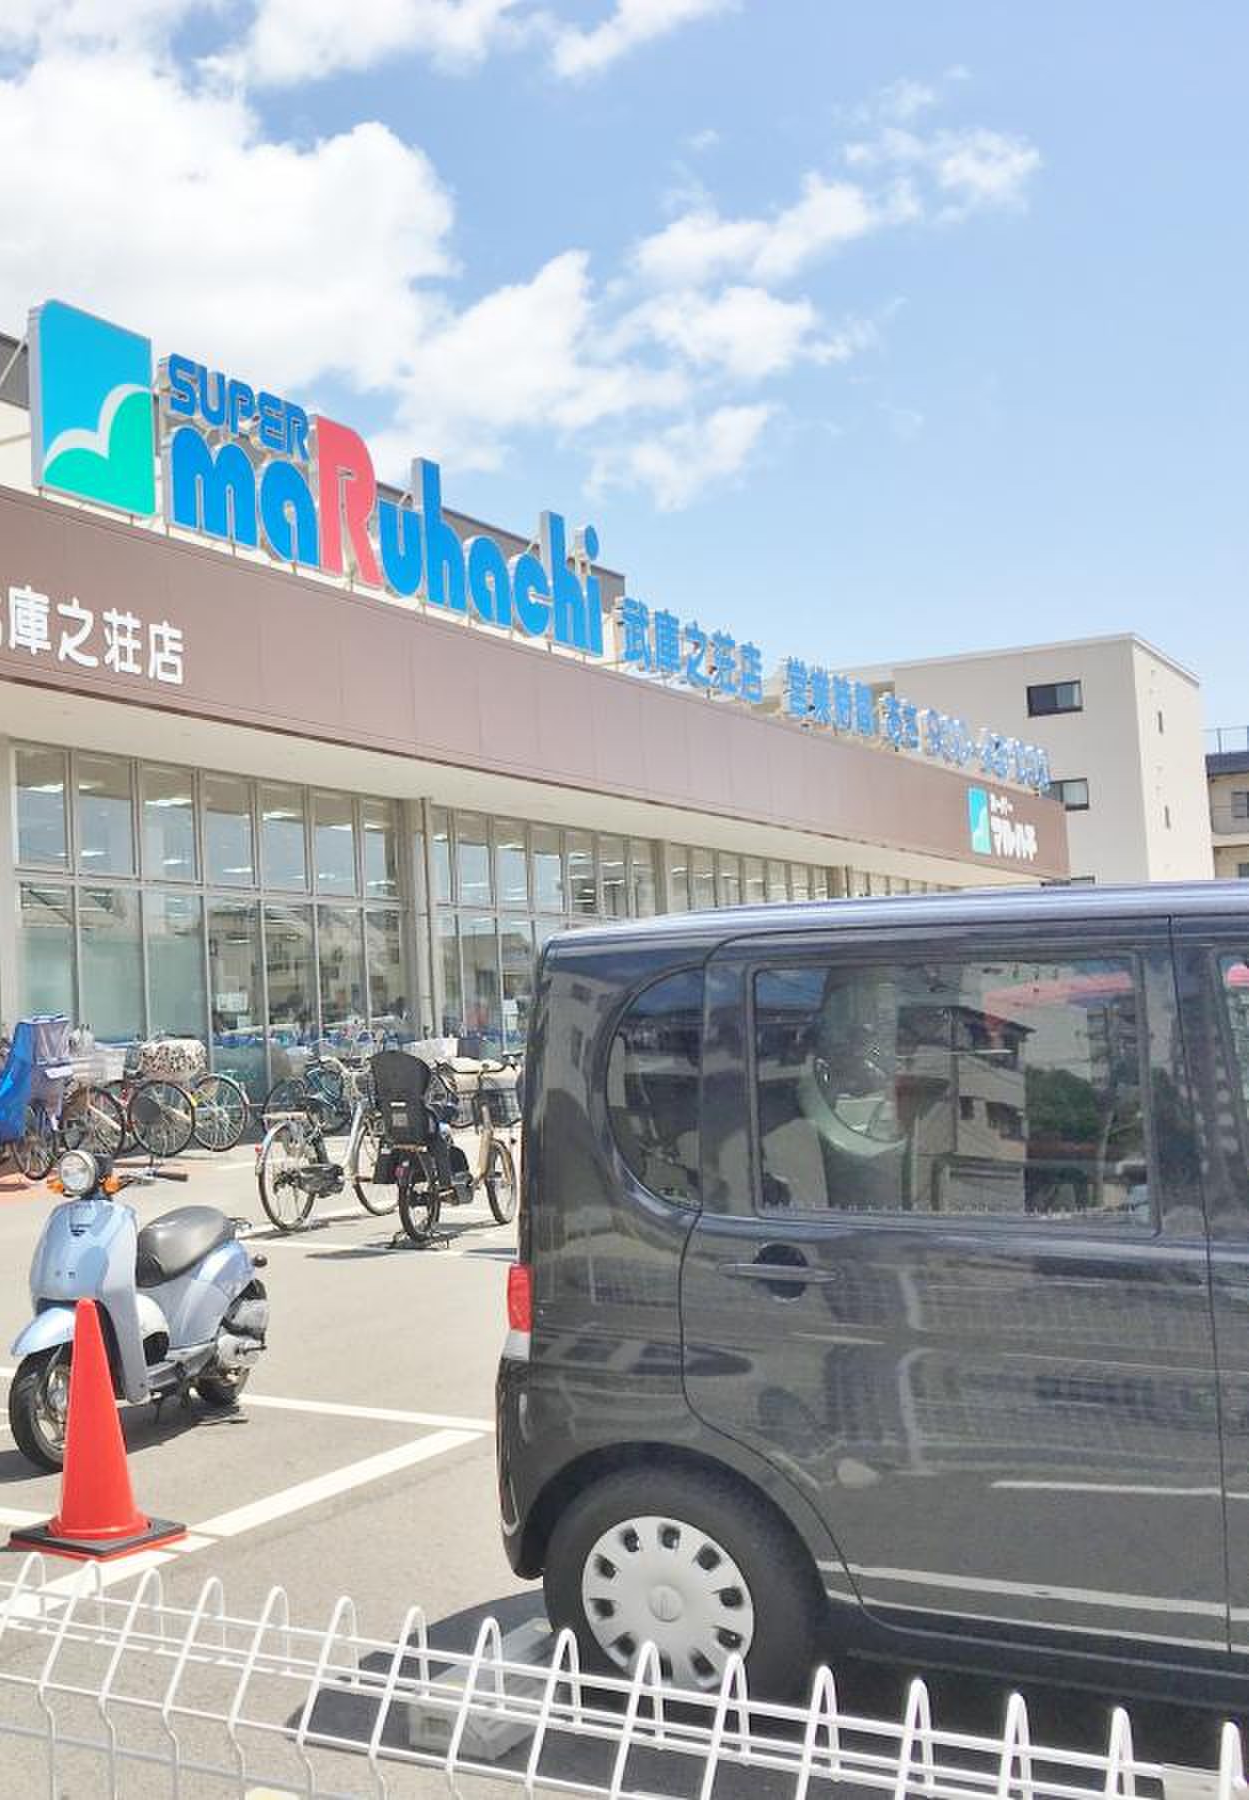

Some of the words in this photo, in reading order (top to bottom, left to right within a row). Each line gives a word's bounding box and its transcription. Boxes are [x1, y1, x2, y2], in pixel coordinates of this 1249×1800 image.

[164, 353, 309, 462] SUPER
[623, 596, 762, 704] 武庫之荘店
